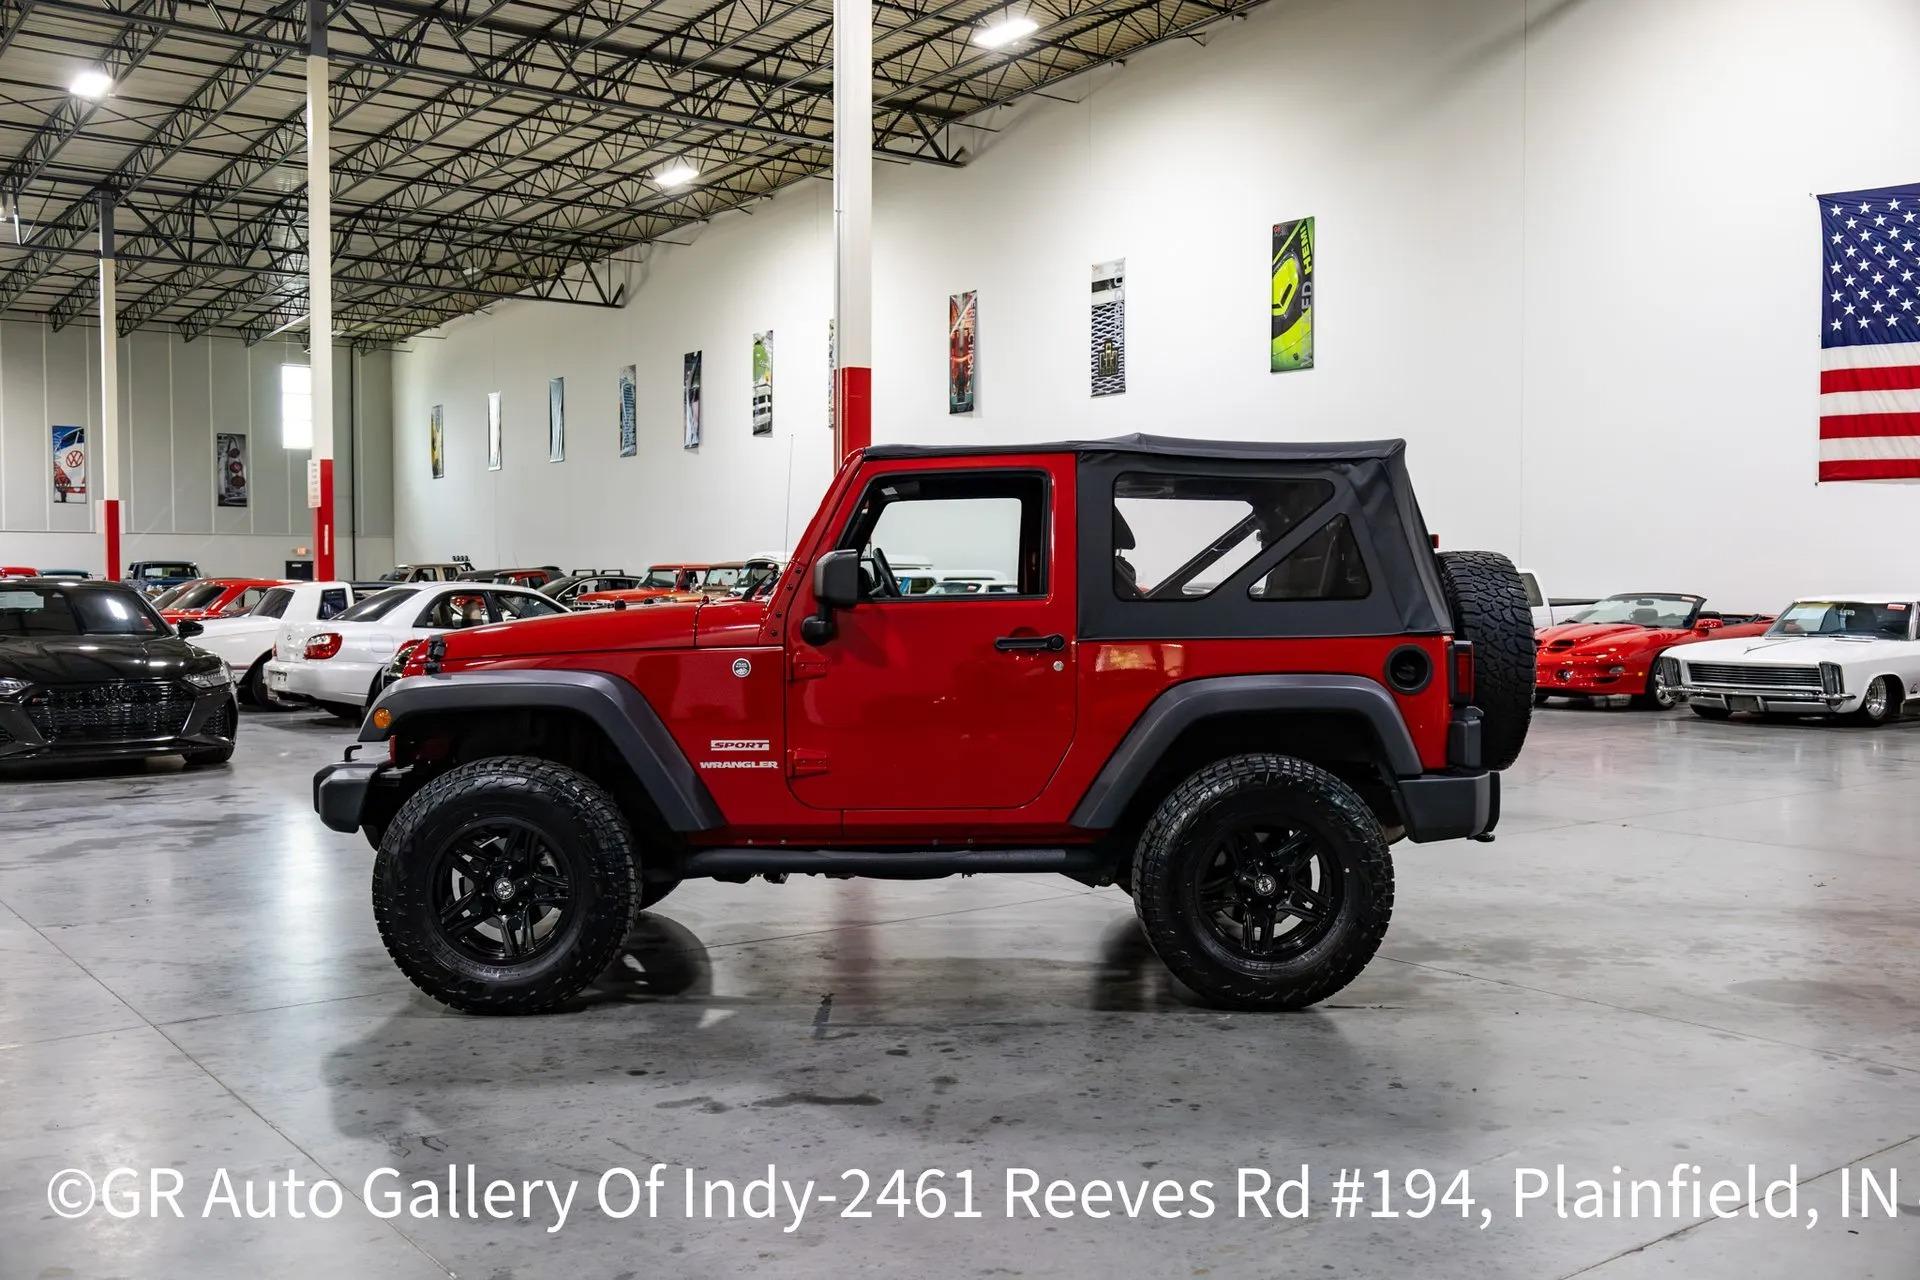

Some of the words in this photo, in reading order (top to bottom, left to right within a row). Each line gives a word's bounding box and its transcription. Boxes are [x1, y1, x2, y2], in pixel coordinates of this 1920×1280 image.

[1300, 225, 1312, 276] HEMI
[712, 741, 769, 749] SPORT
[700, 761, 778, 769] WRANGLER
